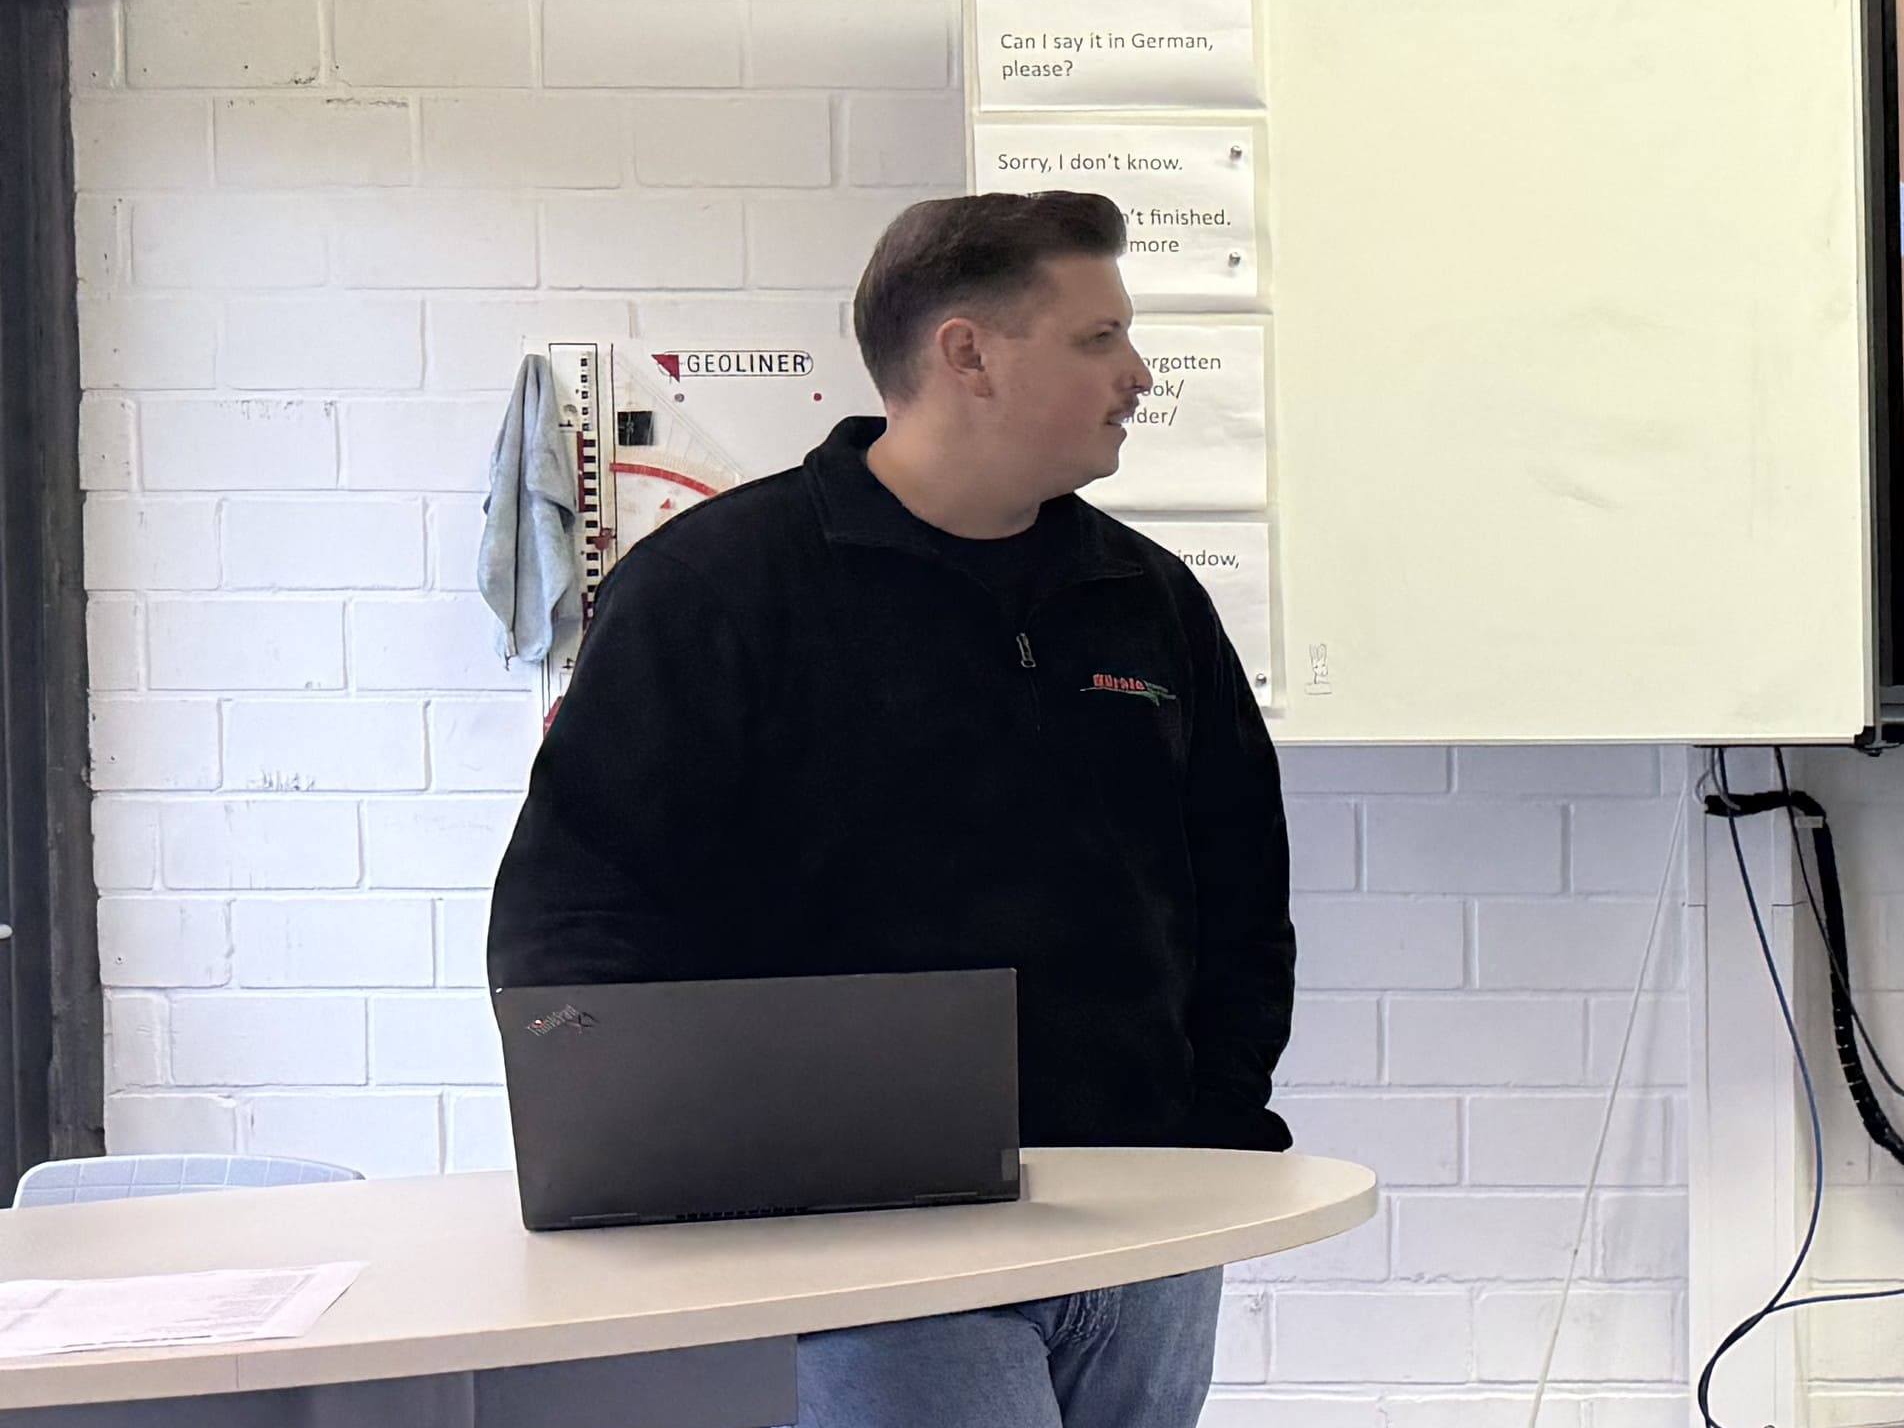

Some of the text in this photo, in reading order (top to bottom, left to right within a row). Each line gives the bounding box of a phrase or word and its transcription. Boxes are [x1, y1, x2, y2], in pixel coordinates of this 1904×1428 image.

[1001, 33, 1213, 52] Can I say it in German,
[1003, 60, 1073, 80] please?
[999, 154, 1182, 173] Sorry, I don't know.
[1151, 209, 1230, 225] finished.
[1130, 241, 1178, 252] more
[688, 353, 805, 373] GEOLINER
